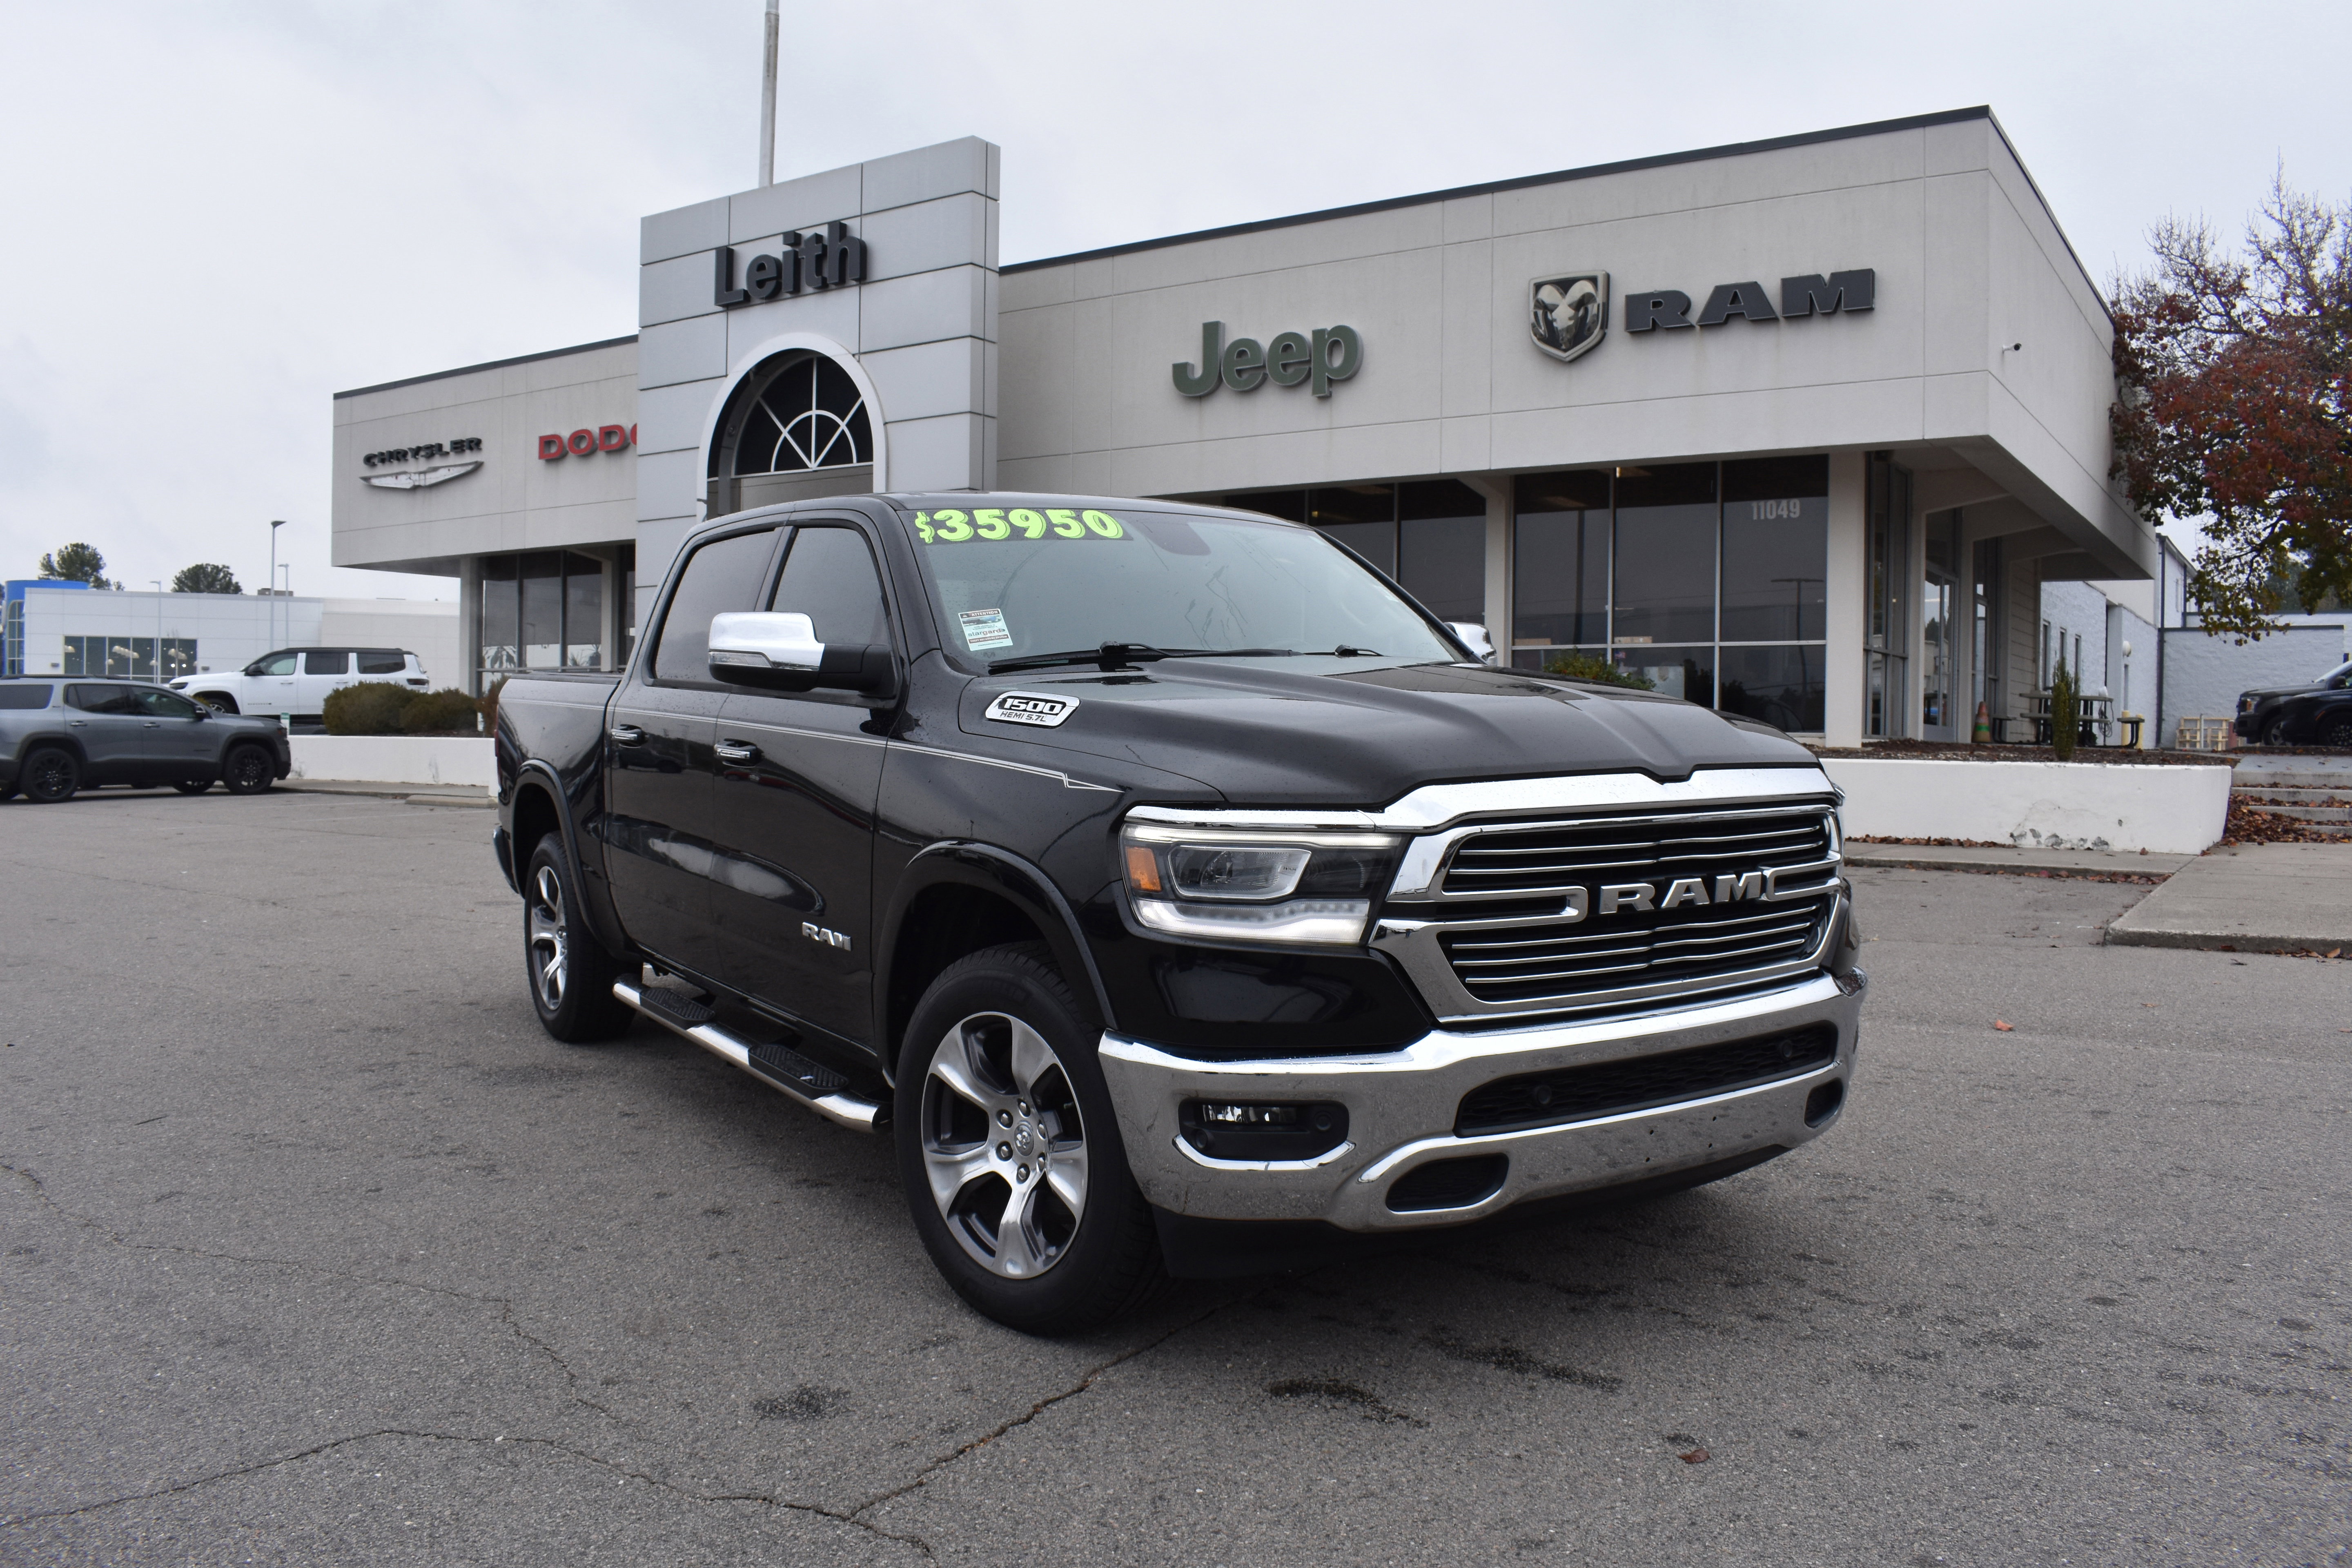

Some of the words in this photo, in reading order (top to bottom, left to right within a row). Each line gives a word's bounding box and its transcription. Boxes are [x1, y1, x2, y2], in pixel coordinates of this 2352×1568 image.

[715, 221, 867, 307] Leith
[1625, 268, 1875, 334] RAM
[1172, 321, 1363, 397] Jeep
[363, 437, 482, 466] CHRYSLER
[1751, 499, 1800, 520] 11049
[915, 509, 1123, 543] $35950
[1000, 711, 1025, 719] HEMI
[1025, 713, 1046, 722] 5.7L
[1004, 698, 1062, 714] 1500
[1599, 871, 1762, 914] RAM
[802, 922, 852, 951] RAM
